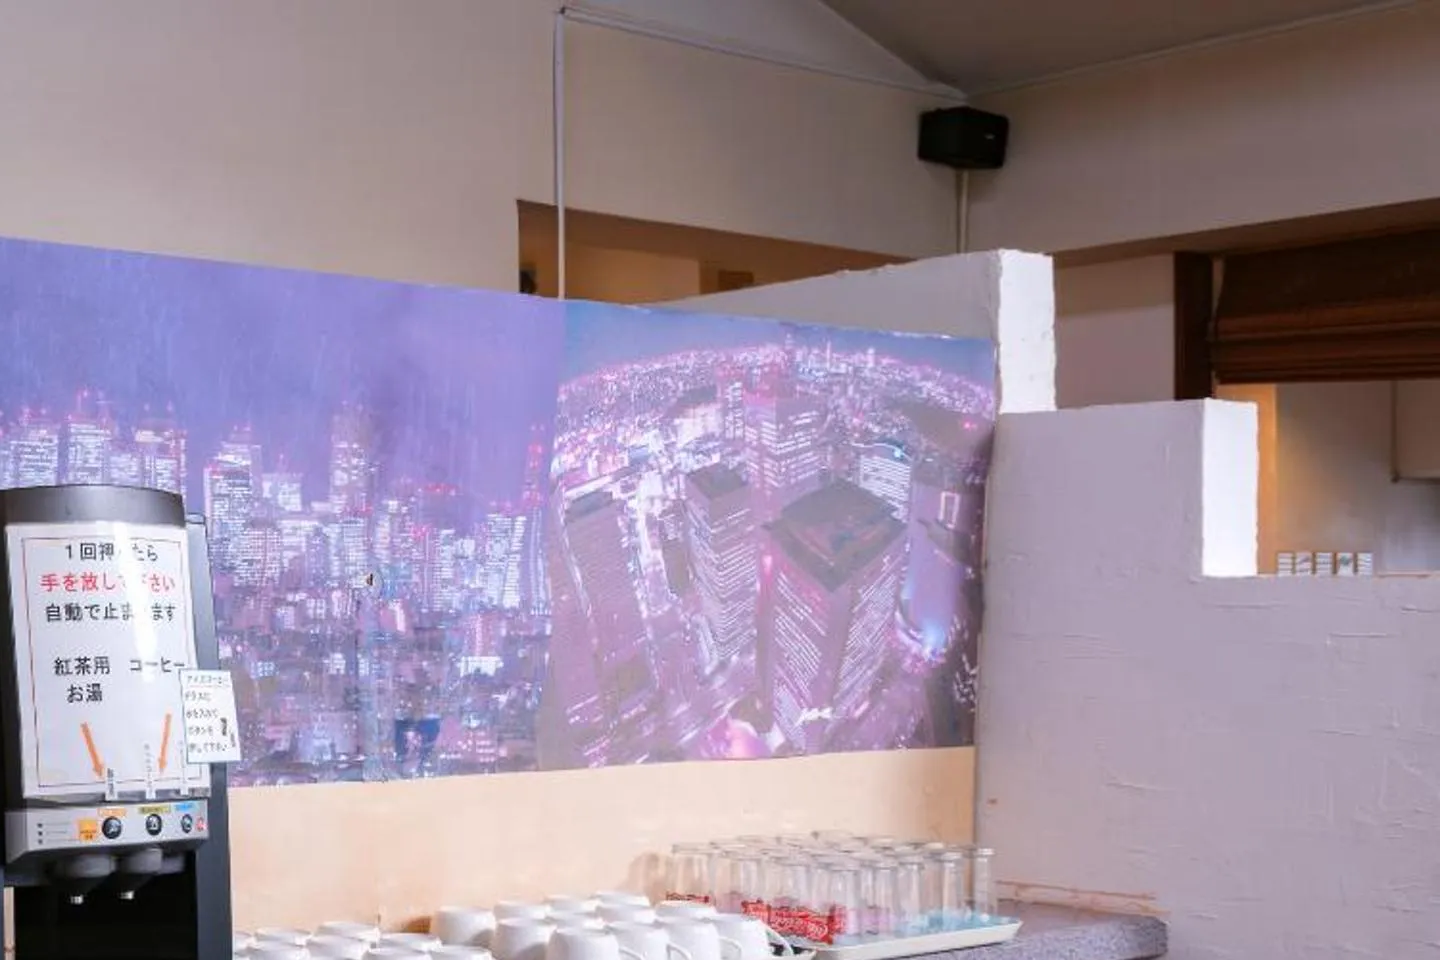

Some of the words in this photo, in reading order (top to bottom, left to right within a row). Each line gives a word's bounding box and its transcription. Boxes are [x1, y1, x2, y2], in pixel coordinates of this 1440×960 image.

[65, 542, 159, 562] 1回押たら
[39, 572, 176, 592] 手を放しさい
[46, 602, 177, 622] 自動で止まます
[53, 656, 110, 676] 紅茶用
[129, 656, 186, 674] コーヒー
[66, 683, 104, 704] お湯
